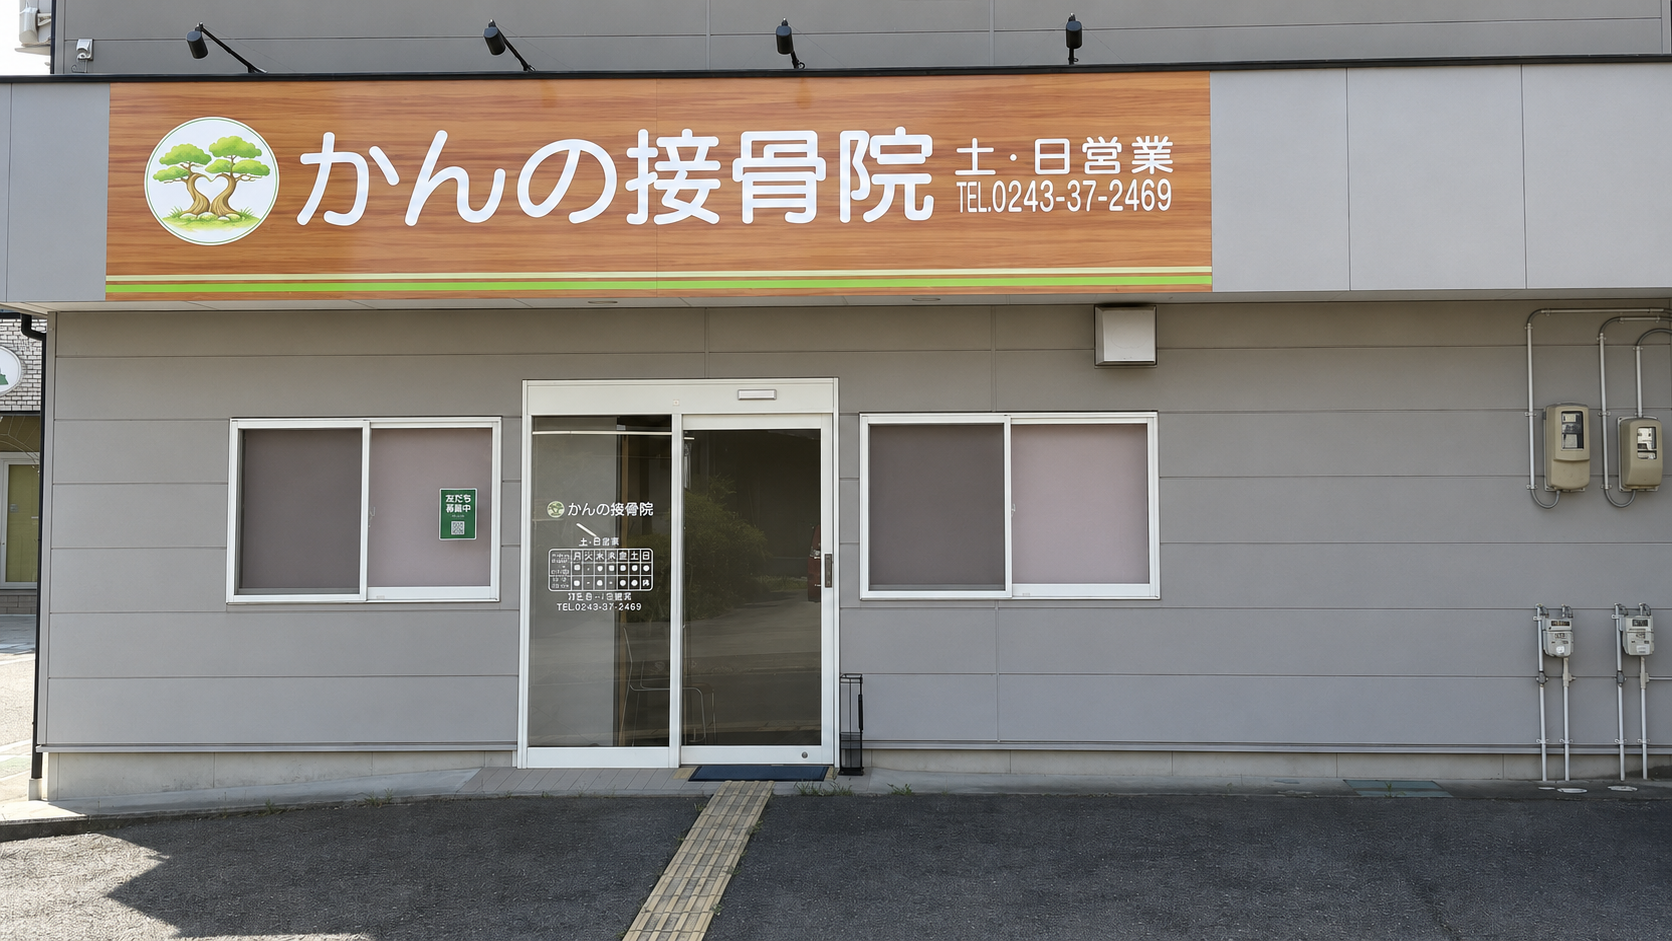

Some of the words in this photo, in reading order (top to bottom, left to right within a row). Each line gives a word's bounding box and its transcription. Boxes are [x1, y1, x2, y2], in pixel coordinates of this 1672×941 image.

[955, 136, 1174, 175] 土・日営業
[296, 126, 935, 226] かんの接骨院
[956, 178, 1172, 213] TEL.0243-37-2469
[568, 502, 654, 517] かんの接骨院
